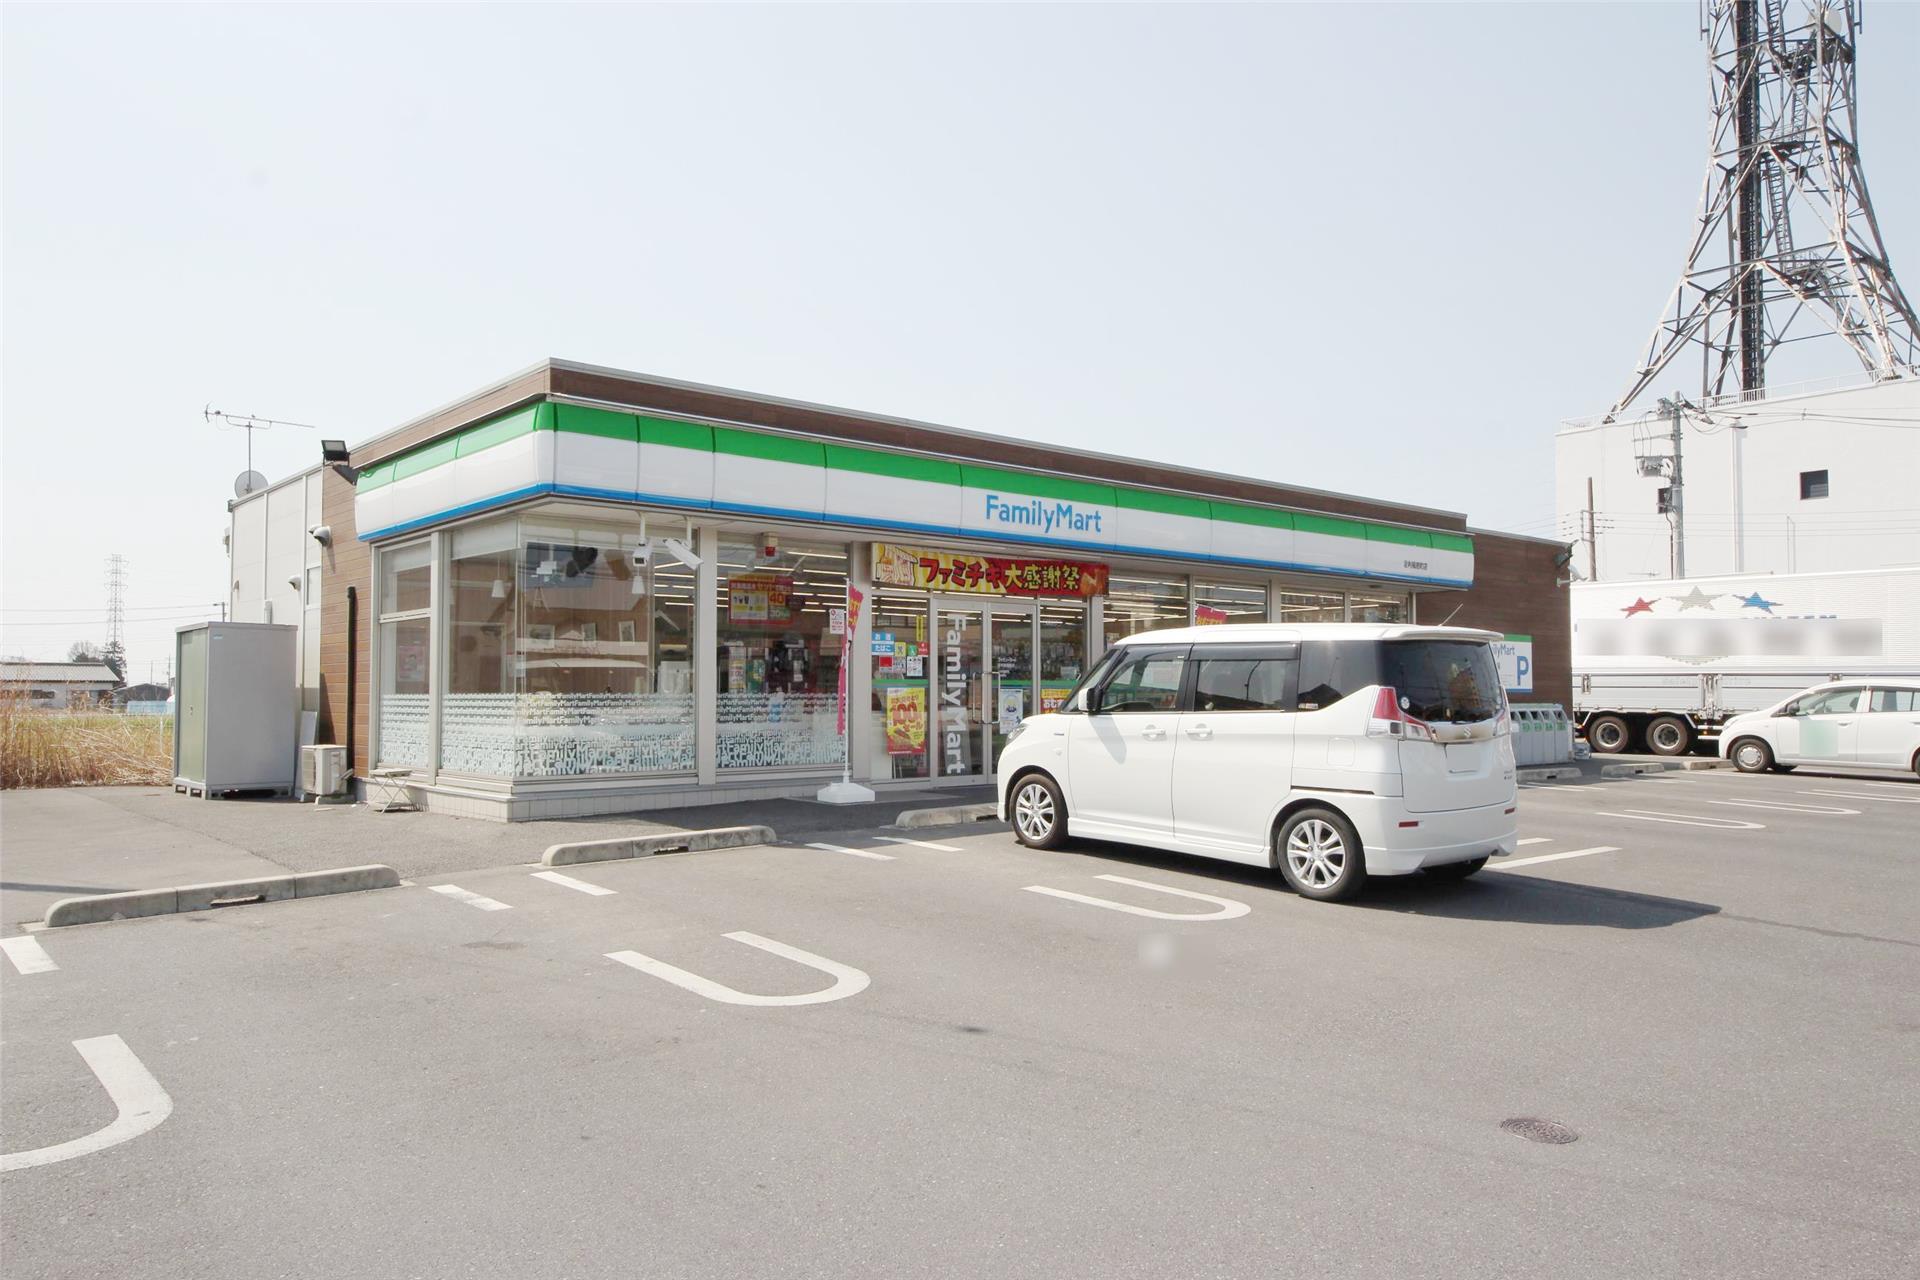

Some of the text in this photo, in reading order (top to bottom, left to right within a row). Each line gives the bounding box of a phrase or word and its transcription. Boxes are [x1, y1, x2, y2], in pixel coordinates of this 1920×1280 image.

[986, 494, 1102, 533] FamilyMart
[919, 557, 1080, 590] ファミチキ大感謝祭
[1517, 656, 1529, 685] P
[942, 614, 967, 774] FamilyMart
